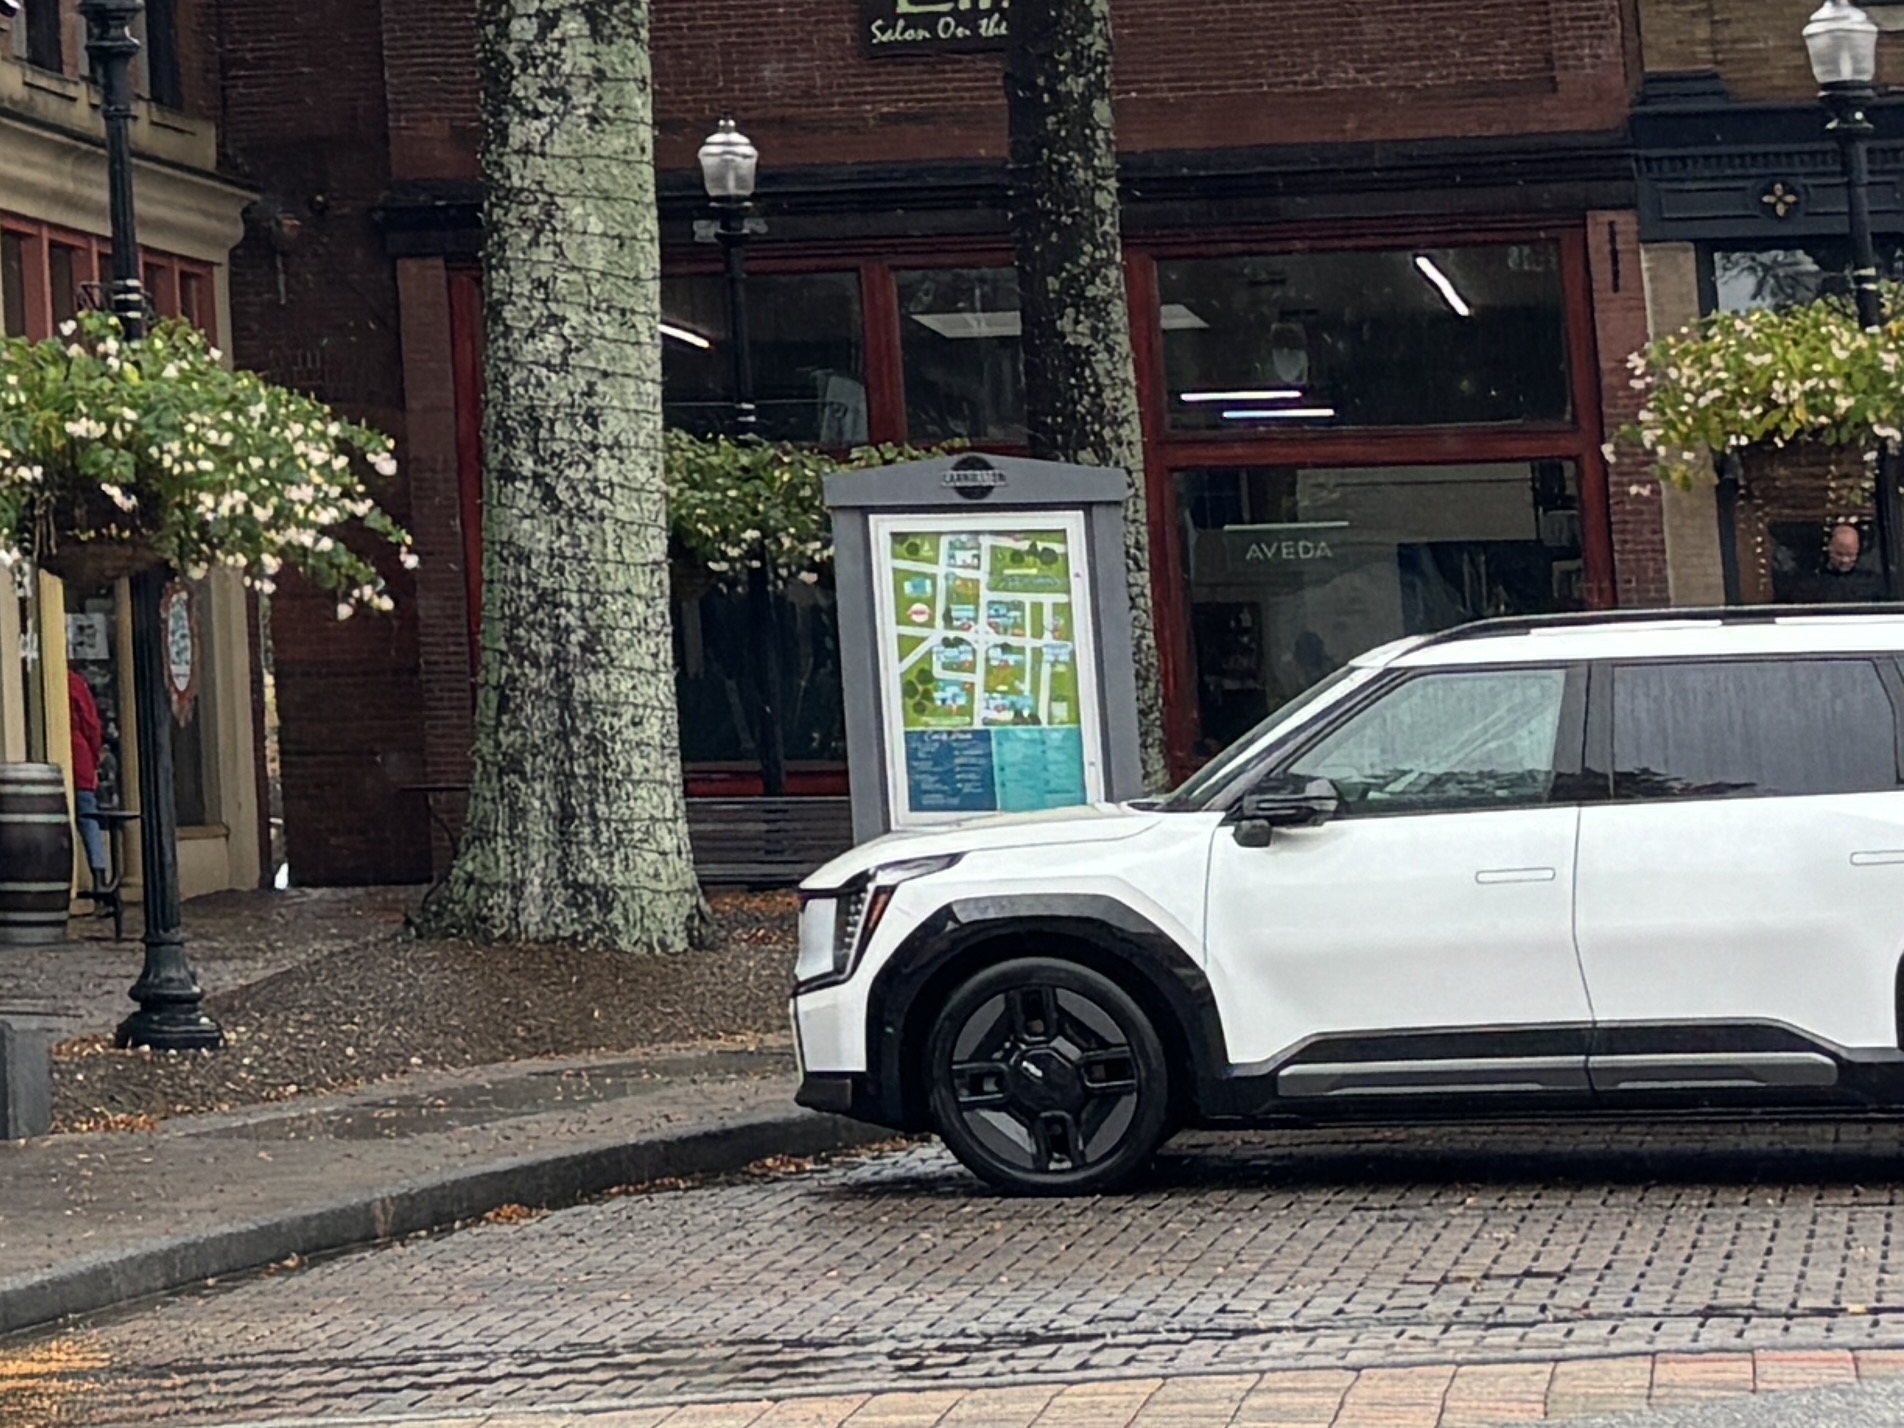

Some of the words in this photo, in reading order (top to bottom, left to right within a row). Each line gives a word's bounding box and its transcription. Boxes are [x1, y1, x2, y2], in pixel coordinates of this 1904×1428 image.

[870, 18, 931, 44] Salon
[937, 16, 972, 39] On
[1245, 540, 1333, 560] AVEDA
